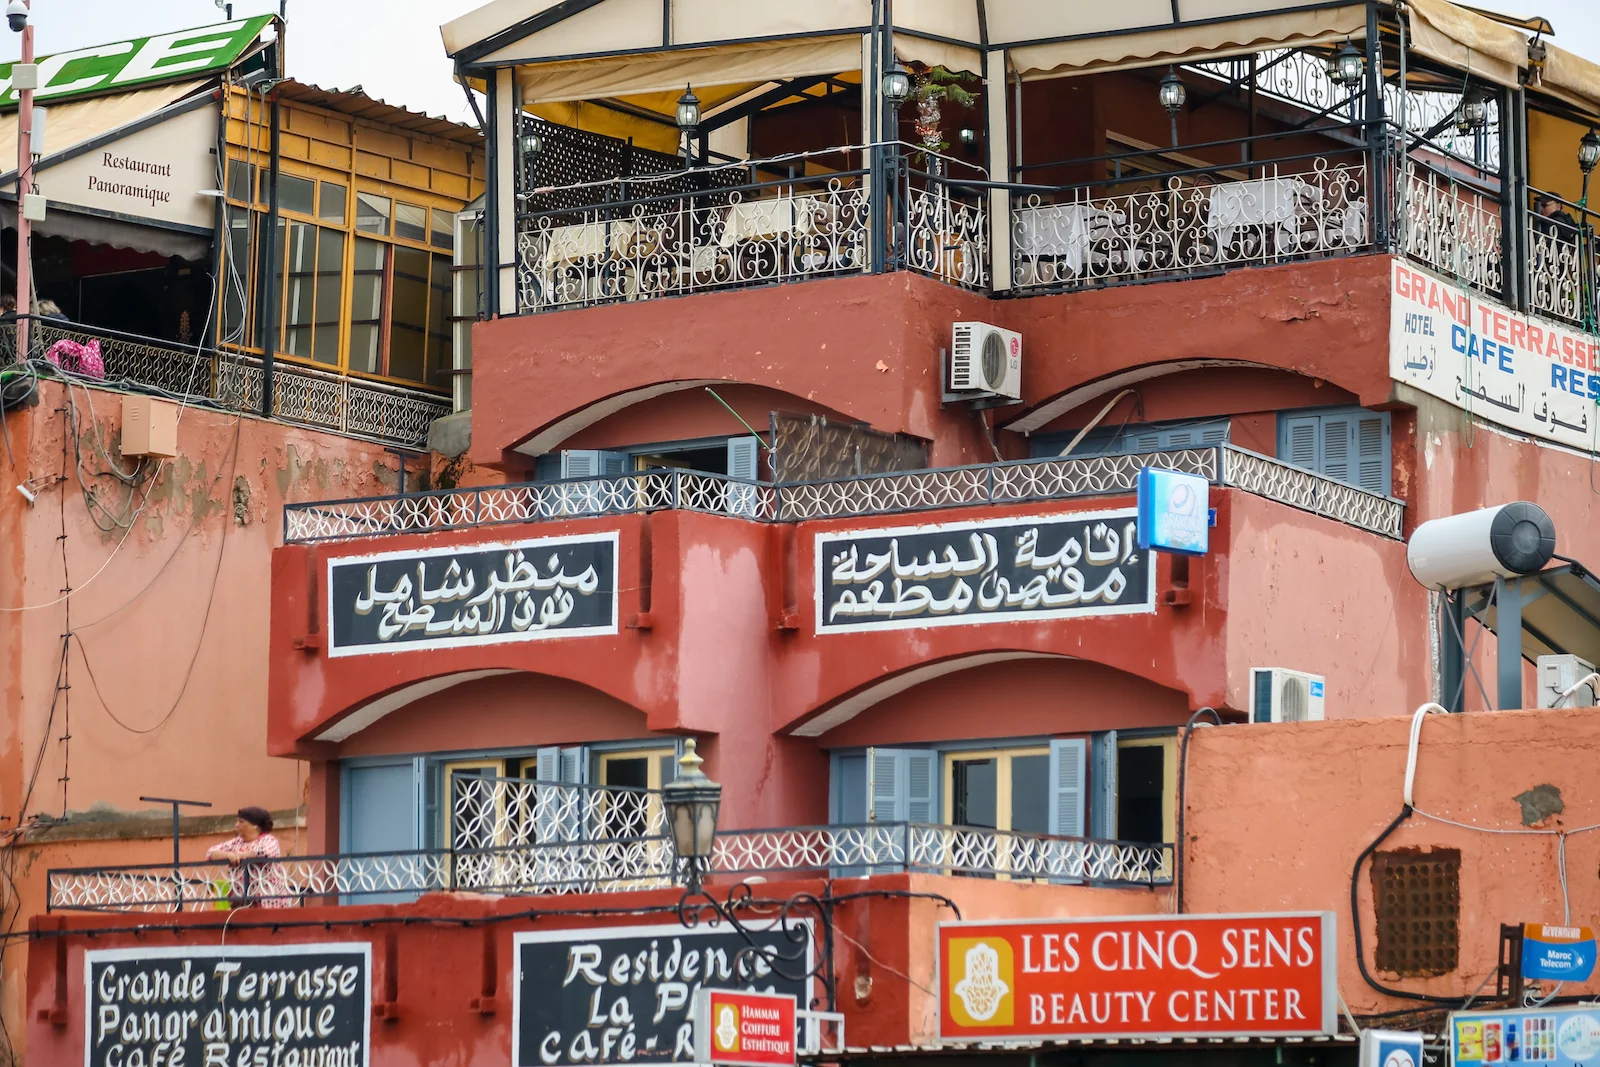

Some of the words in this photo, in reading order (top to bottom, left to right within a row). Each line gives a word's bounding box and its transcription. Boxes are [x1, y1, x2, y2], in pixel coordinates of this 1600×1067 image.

[0, 19, 248, 101] CE
[102, 152, 172, 177] Restaurant
[87, 175, 171, 207] Panoramique
[1395, 265, 1471, 328] GRAND
[1478, 304, 1600, 373] TERRASSE
[1404, 312, 1435, 337] HOTEL
[1451, 323, 1515, 375] CAFE
[1454, 371, 1526, 414] السطح
[1532, 391, 1588, 434] فوق
[464, 550, 599, 596] منظر
[831, 531, 1000, 586] الساحة
[354, 558, 475, 616] شامل
[511, 585, 575, 633] فوق
[828, 577, 974, 623] مطعم
[377, 593, 507, 640] السطح
[1021, 931, 1081, 974] LES
[1091, 929, 1221, 980] CINQ
[1220, 926, 1315, 969] SENS
[1540, 957, 1572, 968] Telecom
[1547, 949, 1572, 960] Maroc
[98, 960, 206, 1002] Grande
[212, 961, 360, 1000] Terrasse
[588, 986, 634, 1028] La
[1029, 990, 1157, 1025] BEAUTY
[1167, 988, 1307, 1023] CENTER
